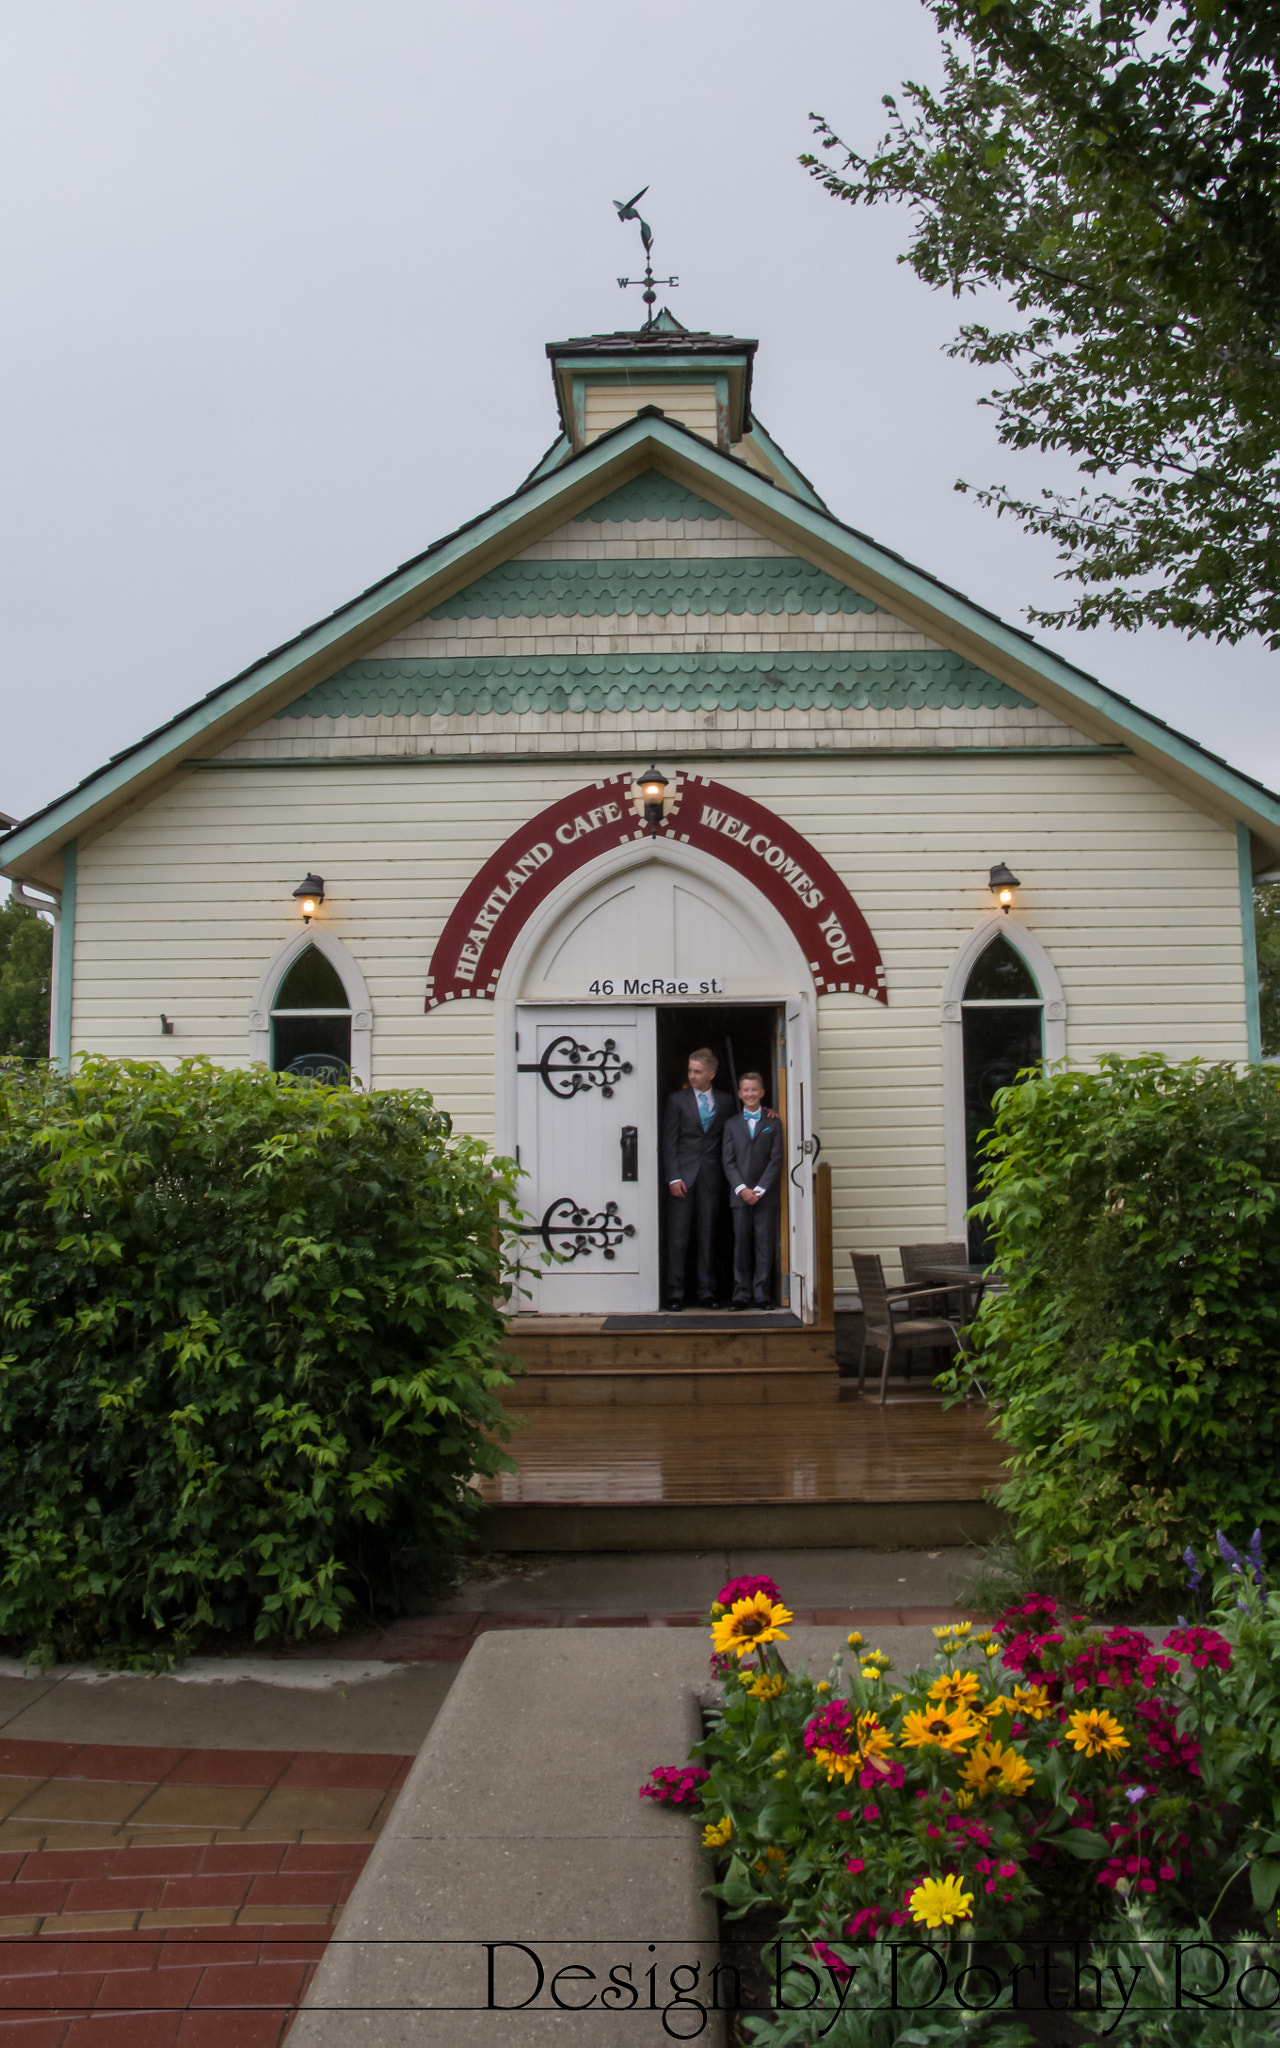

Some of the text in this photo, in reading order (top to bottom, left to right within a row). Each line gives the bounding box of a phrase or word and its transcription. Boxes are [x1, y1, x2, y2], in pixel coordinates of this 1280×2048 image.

[454, 801, 856, 982] HEARTLAND CAFE WELCOMES YOU
[589, 979, 722, 995] 46 McRae st.
